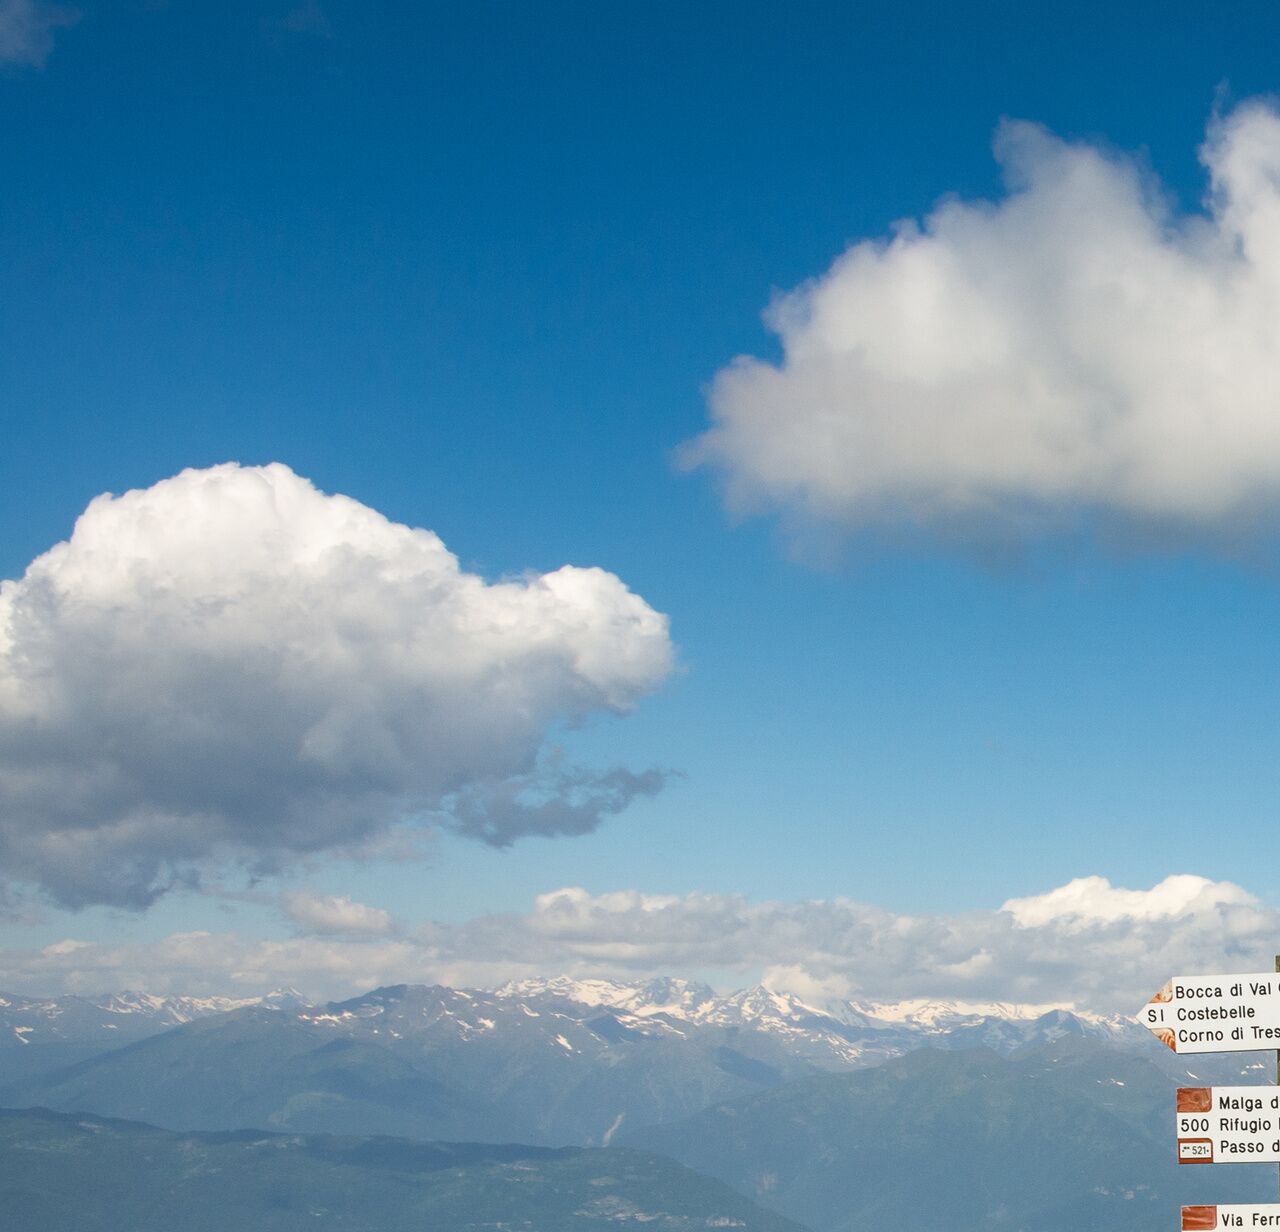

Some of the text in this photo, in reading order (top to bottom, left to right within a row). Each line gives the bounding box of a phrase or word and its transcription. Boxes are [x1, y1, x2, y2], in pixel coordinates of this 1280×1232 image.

[1175, 985, 1222, 998] Bocca
[1229, 983, 1242, 996] di
[1249, 982, 1271, 995] Val
[1177, 1005, 1255, 1021] Costebelle
[1178, 1025, 1280, 1042] Corno di Tres
[1219, 1095, 1262, 1112] Malga
[1180, 1118, 1209, 1132] 500
[1219, 1117, 1271, 1133] Rifugio
[1220, 1140, 1264, 1153] Passo
[1221, 1213, 1243, 1226] Via
